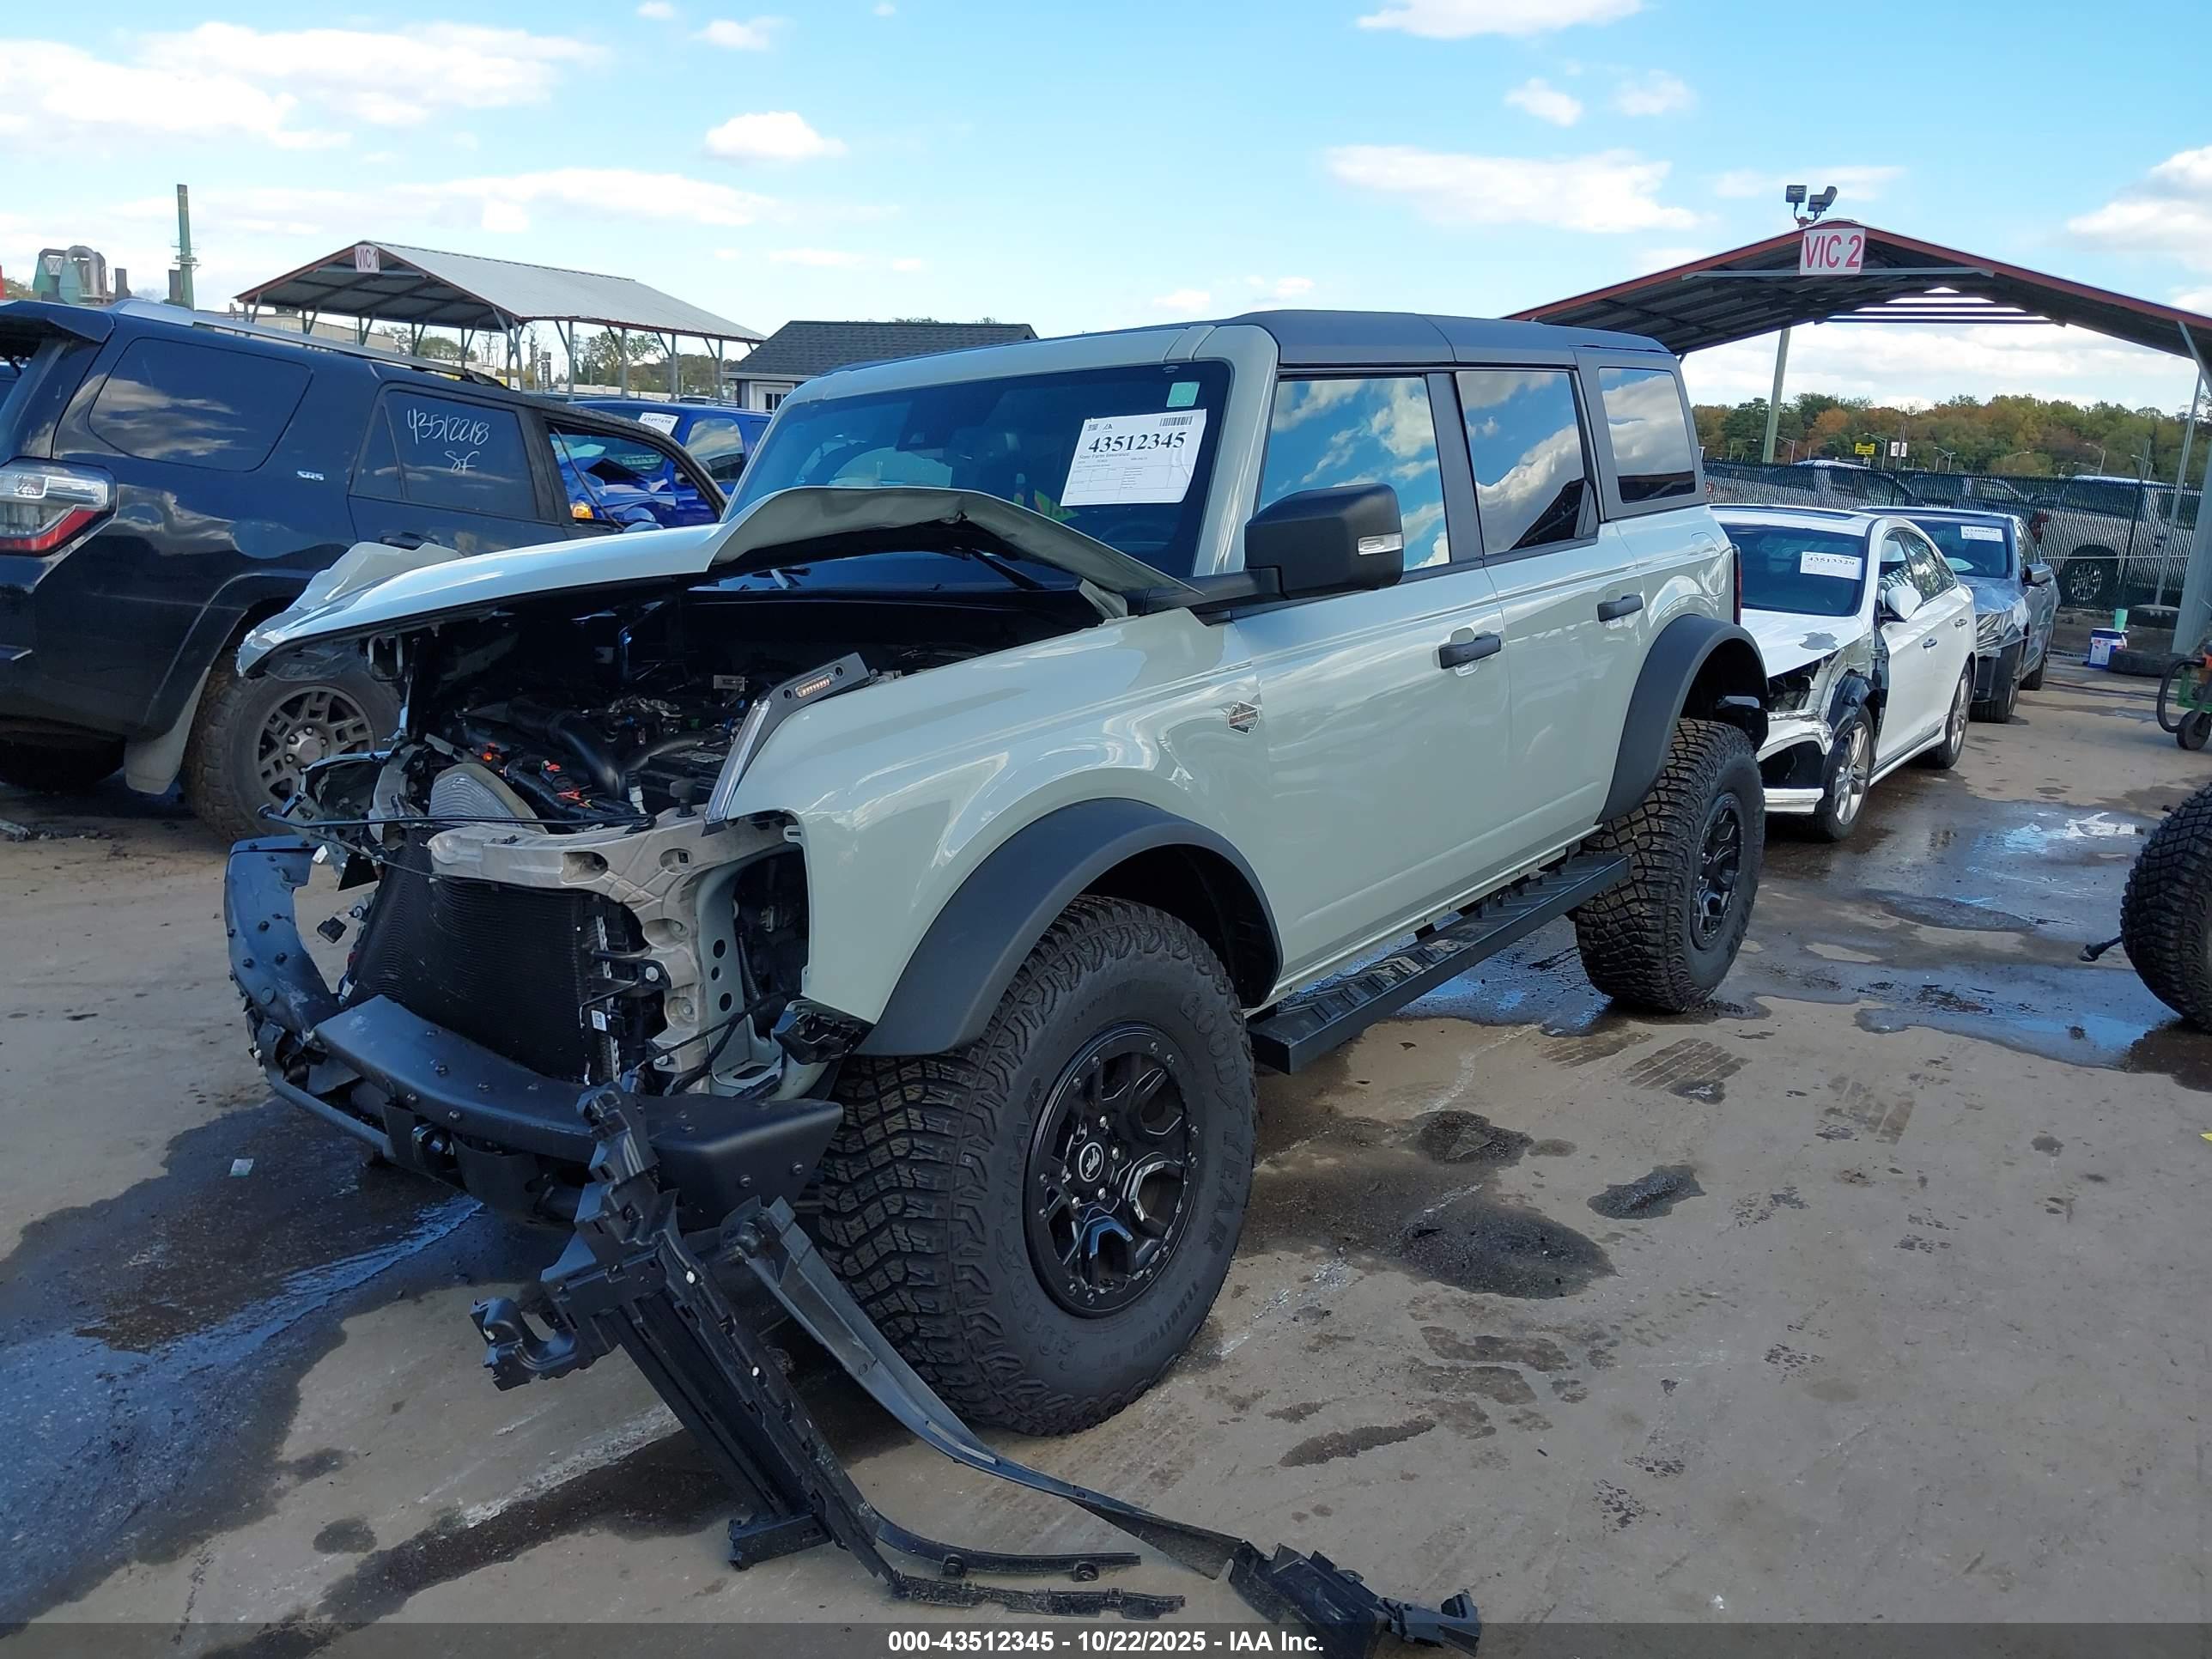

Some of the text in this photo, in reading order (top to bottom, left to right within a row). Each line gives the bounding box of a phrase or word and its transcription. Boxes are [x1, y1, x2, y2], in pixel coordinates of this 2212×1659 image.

[356, 248, 379, 268] VIC 1
[1805, 234, 1863, 268] VIC 2
[407, 408, 489, 446] 43512218
[1088, 431, 1188, 453] 43512345
